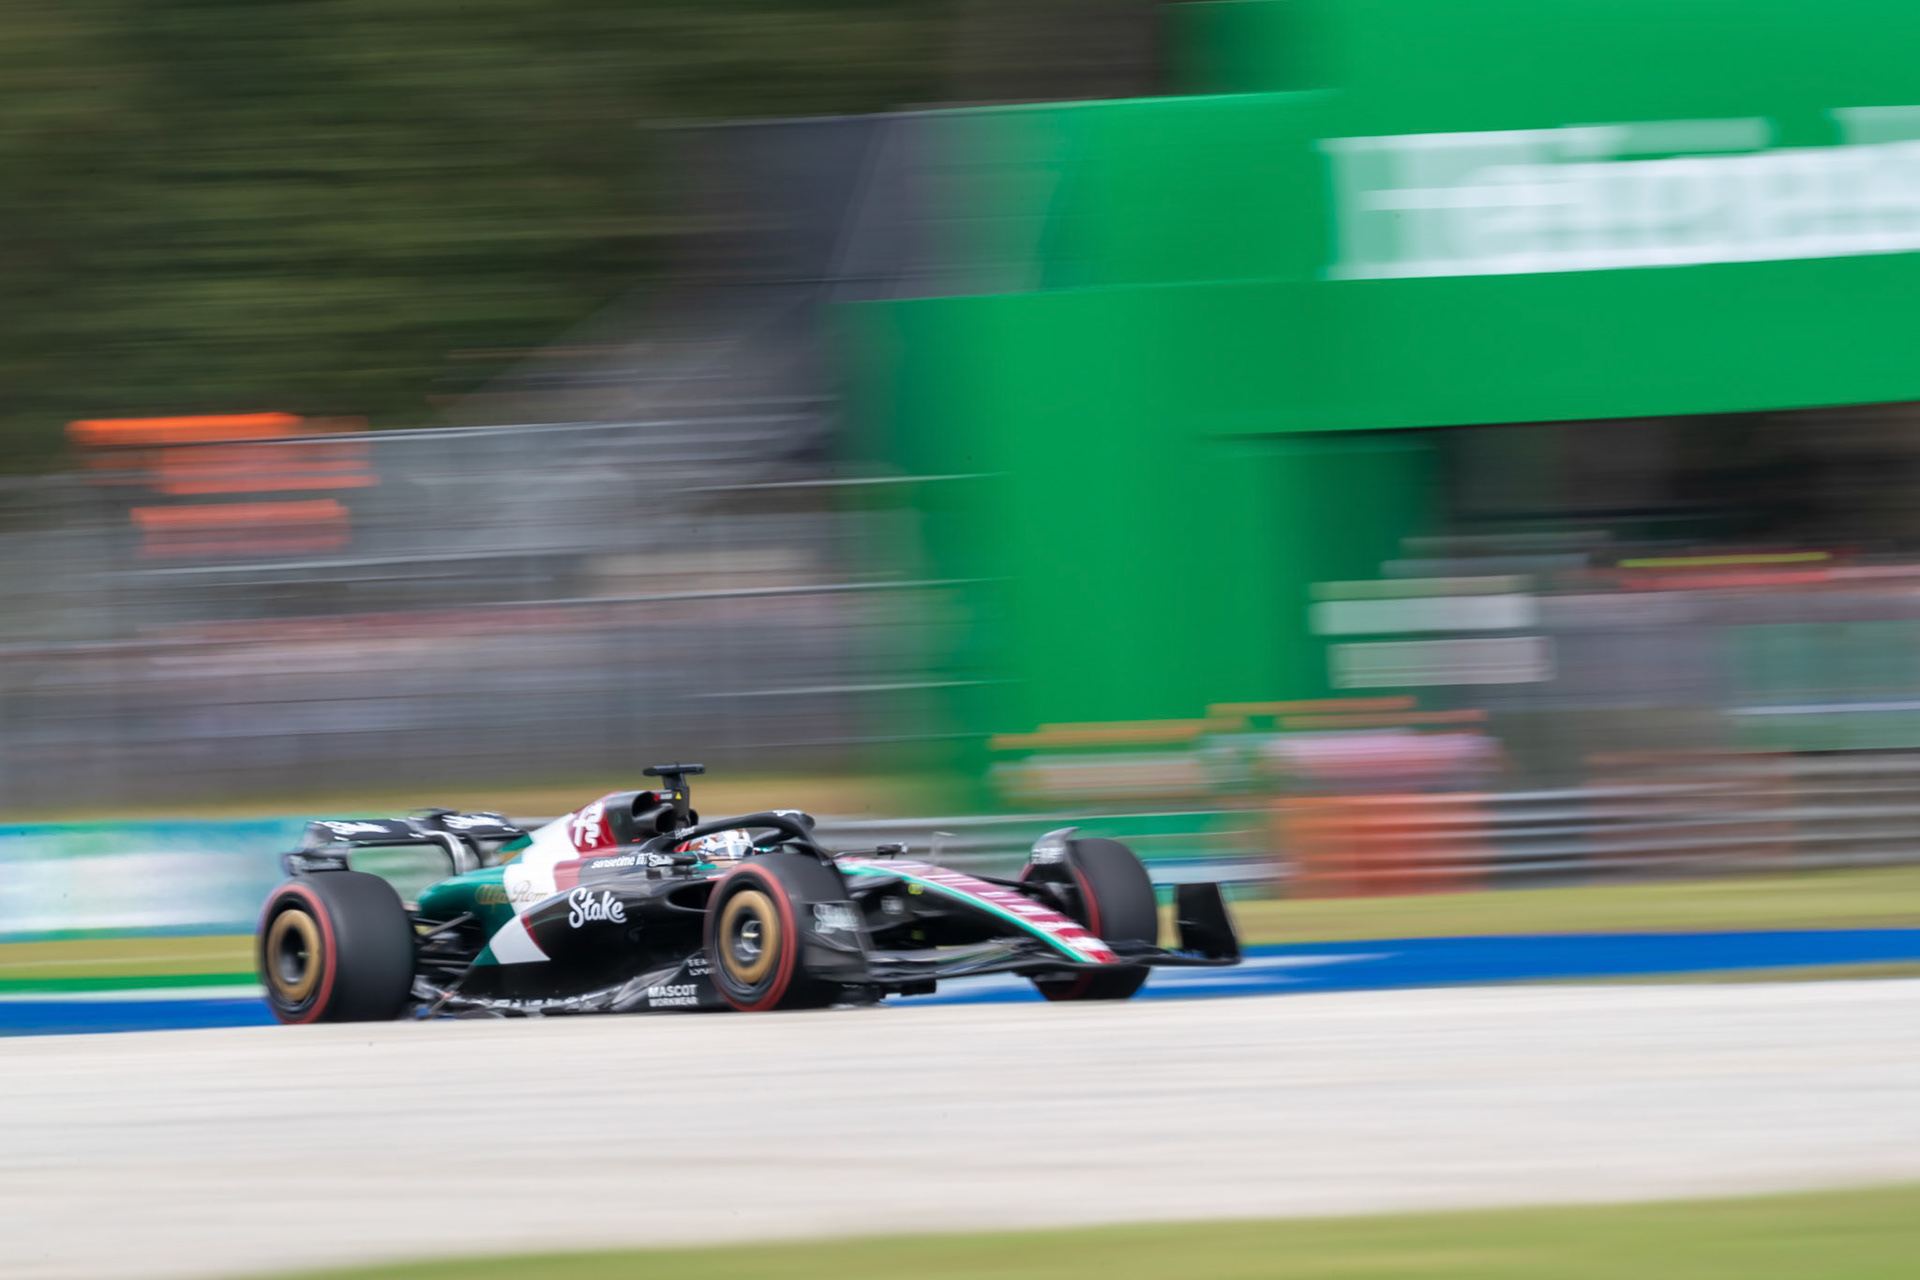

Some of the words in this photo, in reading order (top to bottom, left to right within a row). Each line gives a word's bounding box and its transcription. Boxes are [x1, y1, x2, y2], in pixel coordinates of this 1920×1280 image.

[591, 856, 635, 869] sensetime
[568, 887, 627, 929] Stake
[648, 984, 699, 998] MASCOT
[649, 996, 699, 1007] WORKWEAR
